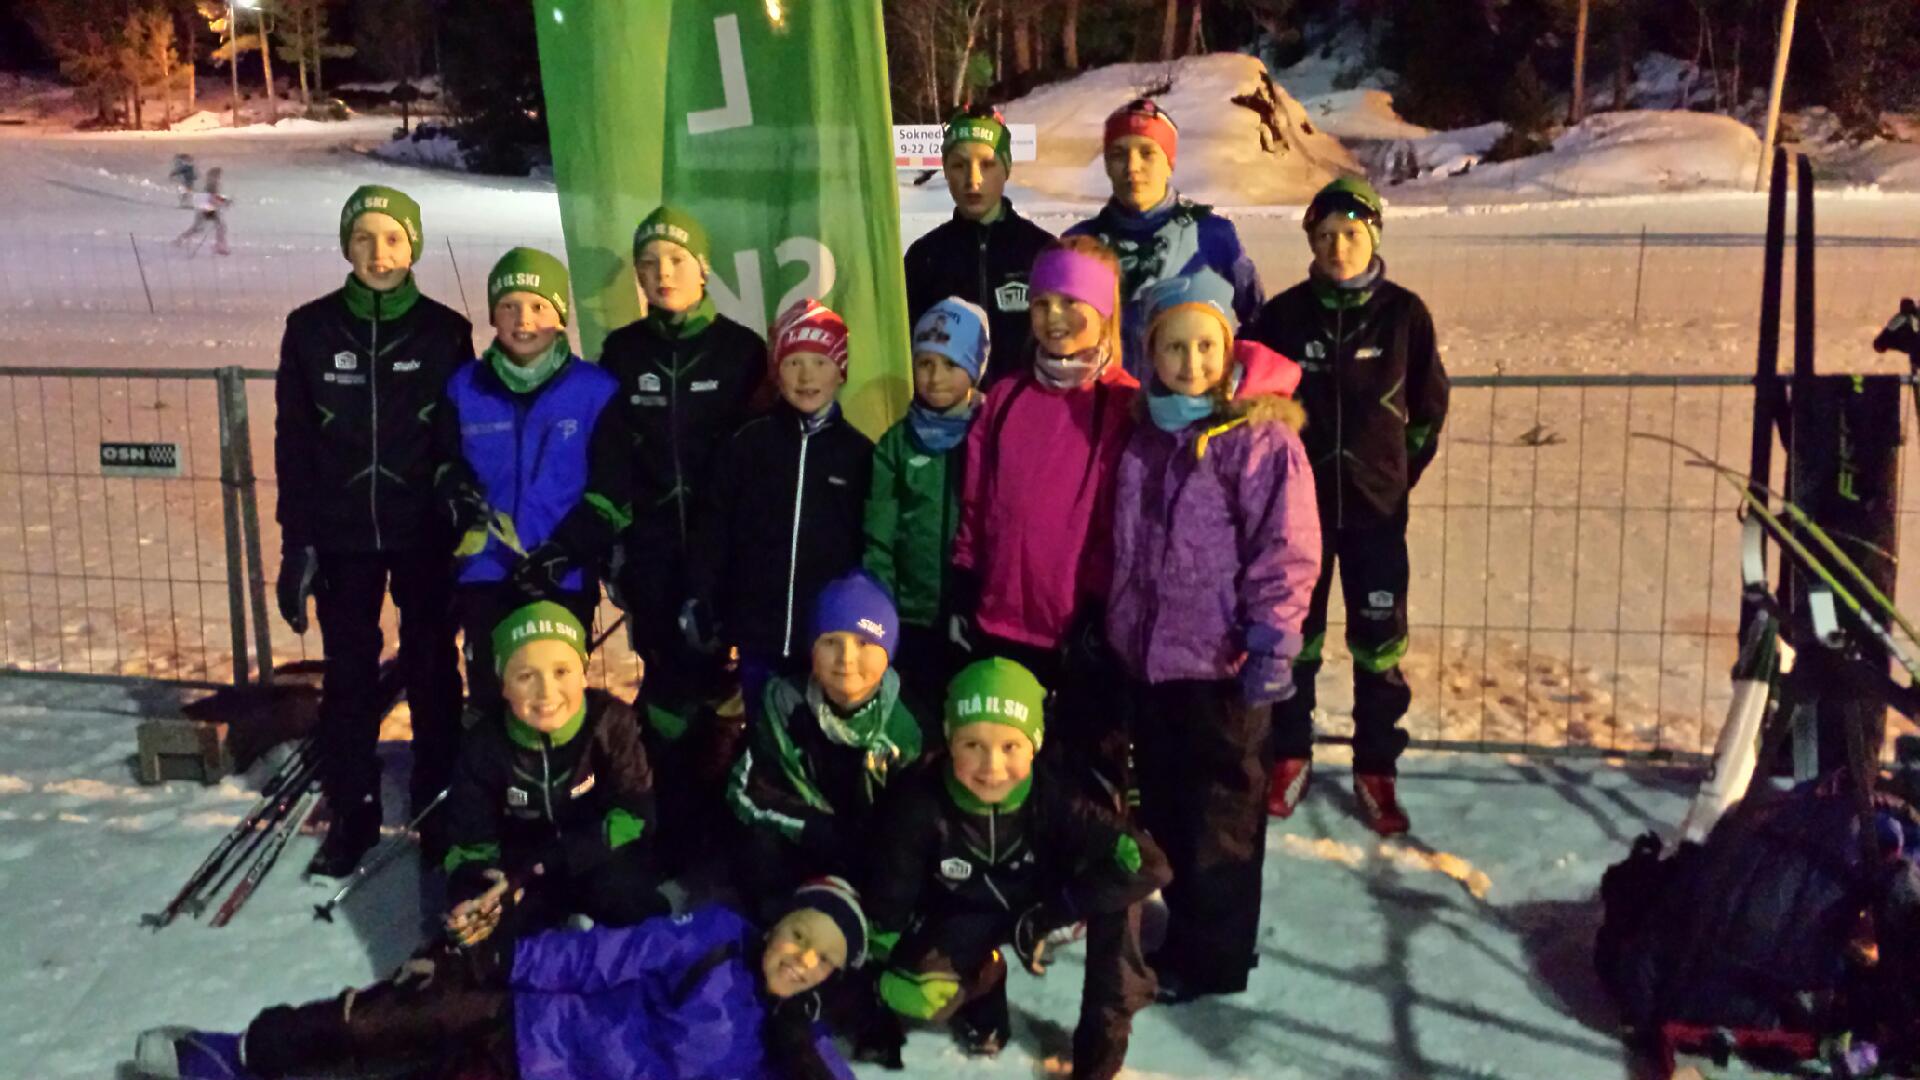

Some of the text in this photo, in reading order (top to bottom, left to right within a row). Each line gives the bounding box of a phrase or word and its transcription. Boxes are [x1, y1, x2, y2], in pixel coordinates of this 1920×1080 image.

[899, 128, 943, 140] Sokned
[973, 126, 994, 141] SKI
[900, 143, 942, 155] 9-22 (2
[365, 197, 388, 208] SKI
[516, 272, 541, 288] SKI
[102, 446, 146, 461] OSN
[556, 622, 577, 641] SKI
[1004, 699, 1029, 723] SKI
